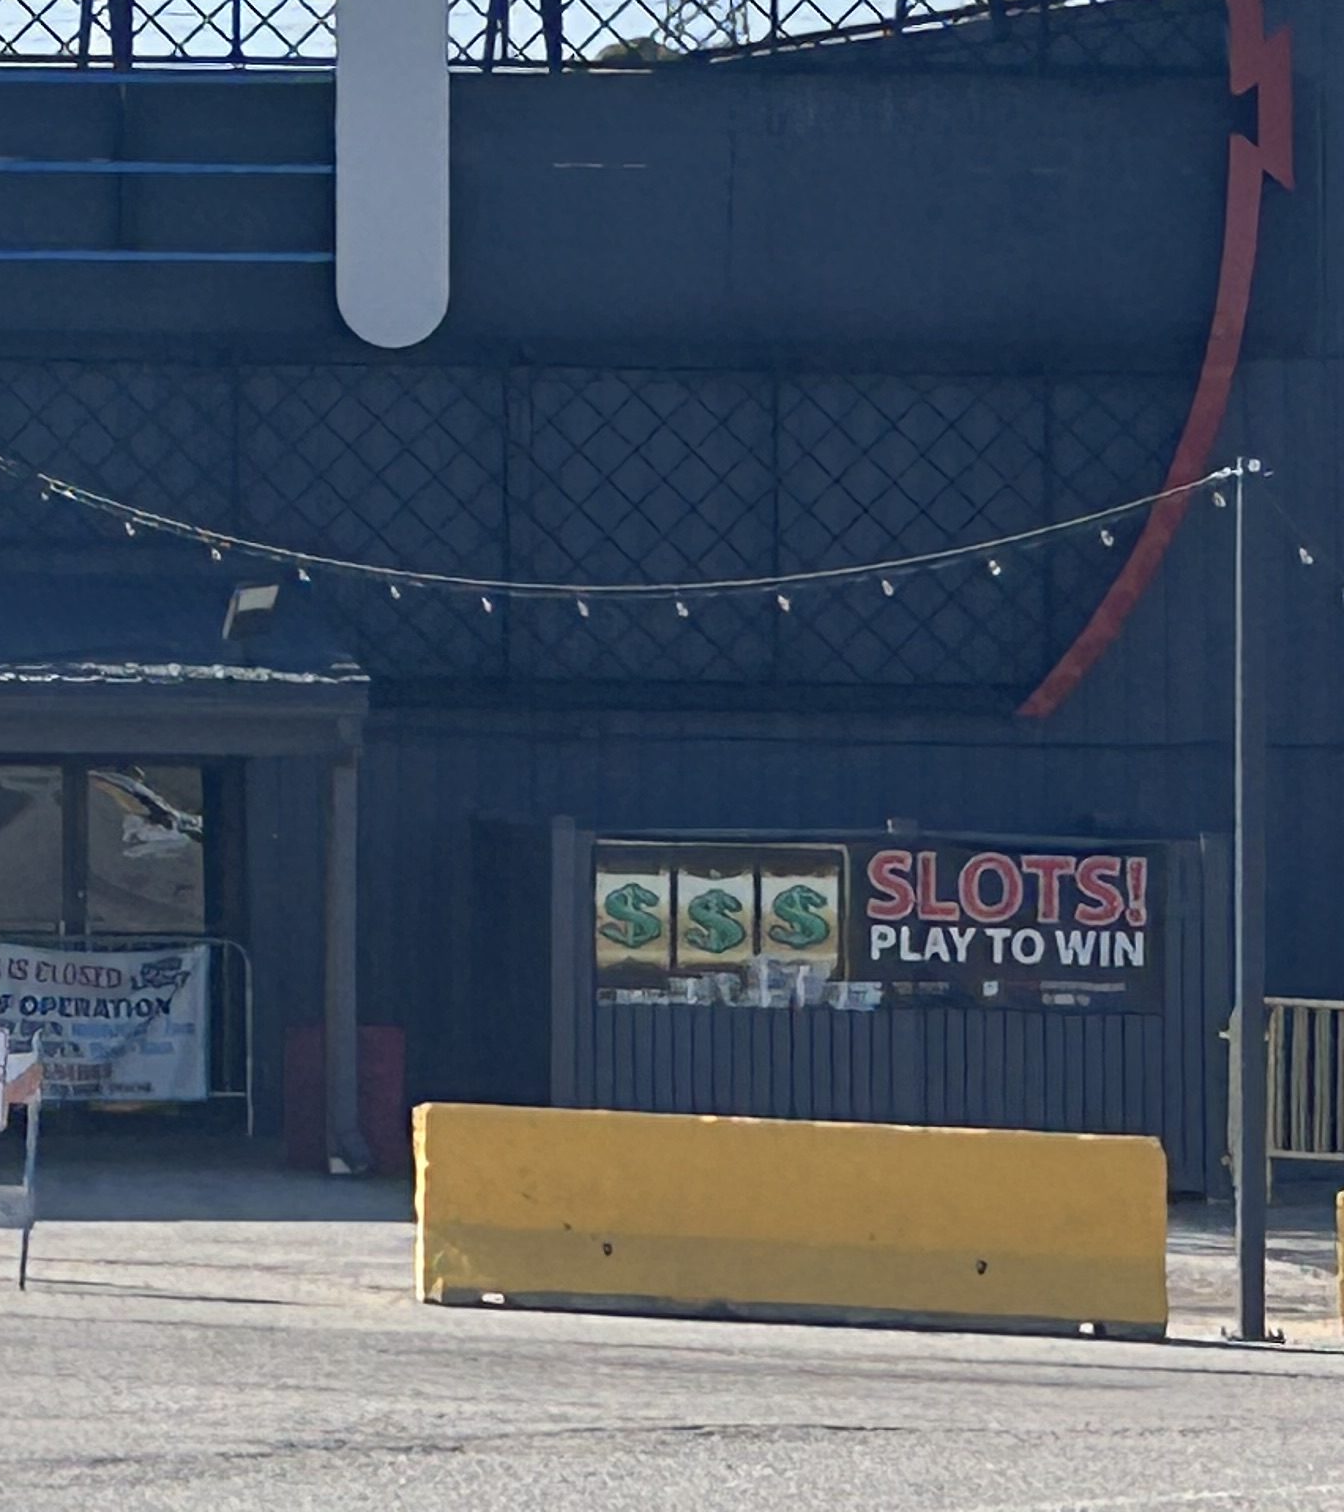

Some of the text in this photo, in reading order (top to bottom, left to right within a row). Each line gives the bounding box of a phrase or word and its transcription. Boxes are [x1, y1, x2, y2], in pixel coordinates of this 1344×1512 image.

[867, 849, 1148, 926] SLOTS!
[870, 925, 1146, 967] PLAY TO WIN
[19, 994, 173, 1019] OPERATION
